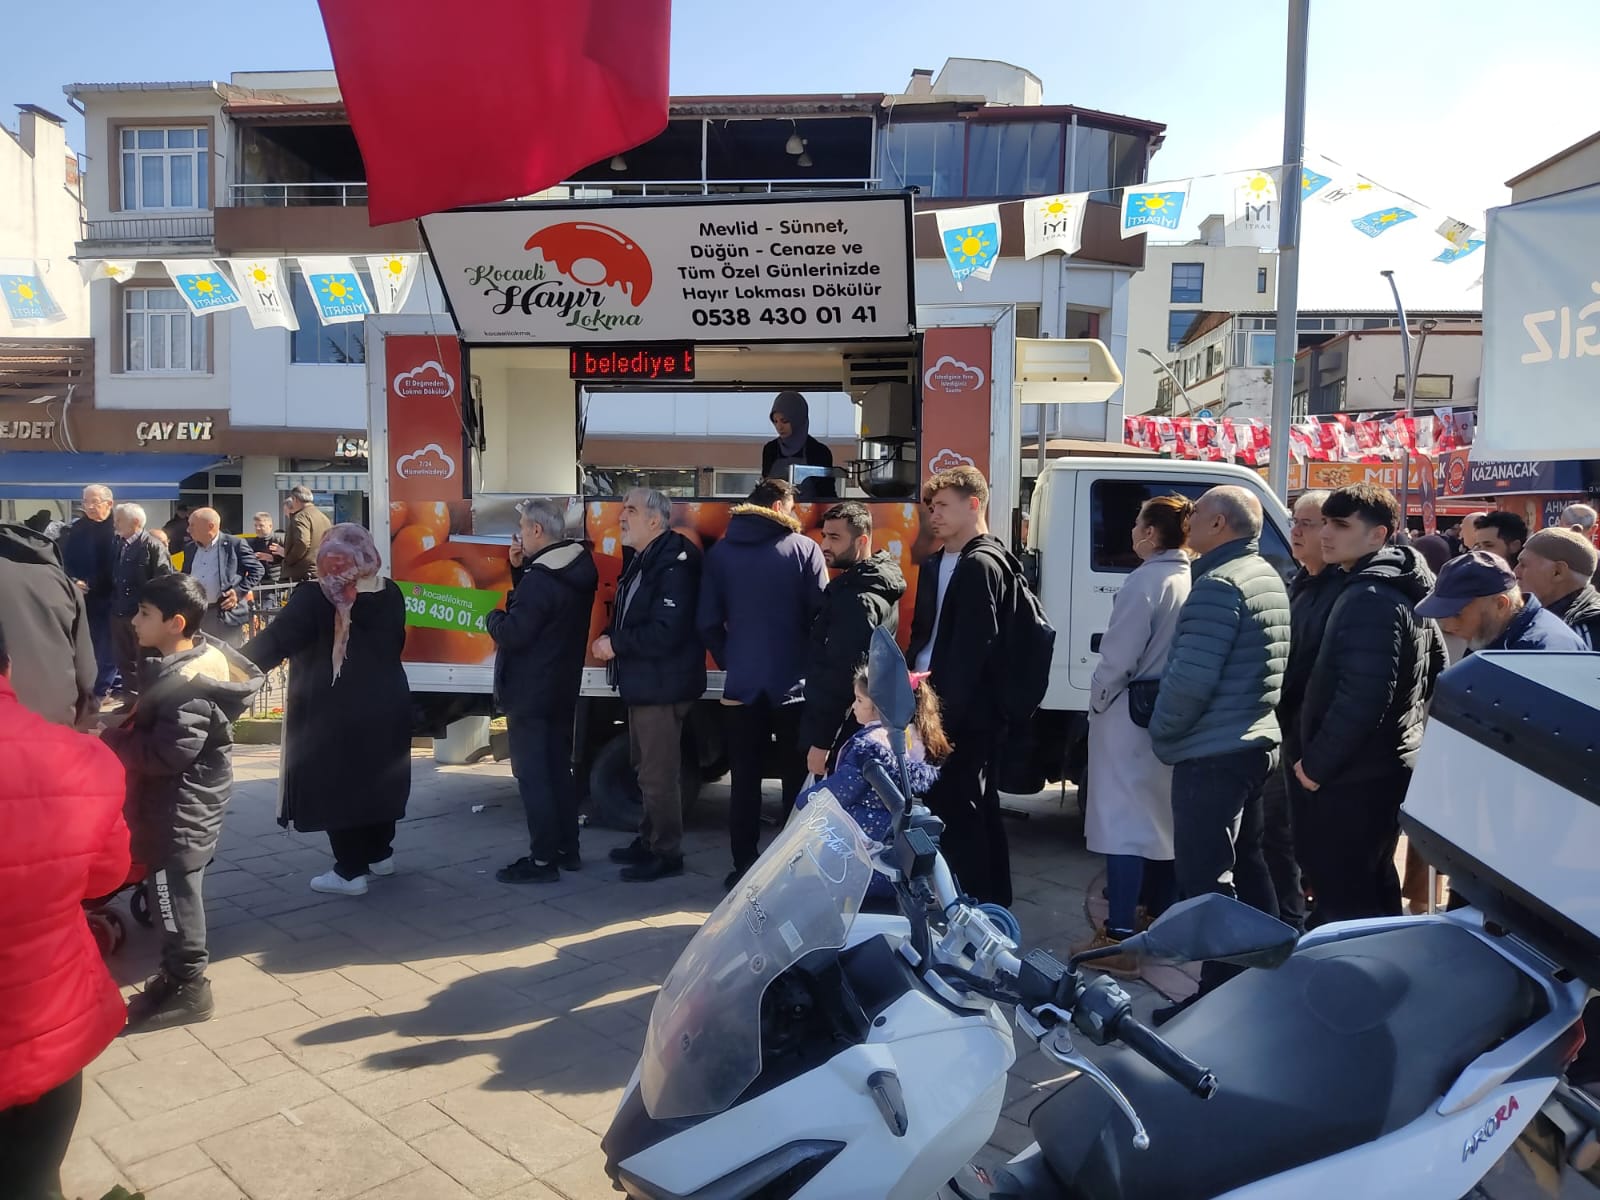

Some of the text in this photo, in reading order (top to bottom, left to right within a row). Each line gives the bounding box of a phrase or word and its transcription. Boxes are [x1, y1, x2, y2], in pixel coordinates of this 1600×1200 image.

[1245, 200, 1271, 221] İYİ
[700, 221, 758, 236] Mevlid
[779, 219, 849, 235] Sünnet,
[1043, 217, 1068, 236] İYİ
[690, 244, 749, 261] Düğün
[770, 242, 836, 257] Cenaze
[842, 243, 863, 254] ve
[464, 263, 547, 288] Kocaeli
[677, 261, 881, 279] Tüm Özel Günlerinizde
[484, 280, 606, 317] Hayır
[682, 282, 882, 303] Hayır Lokması Dökülür
[566, 309, 644, 331] Lokma
[692, 305, 877, 327] 0538 430 01 41
[585, 351, 675, 379] belediye
[136, 416, 213, 446] ÇAY EVİ
[1471, 462, 1539, 481] KAZANACAK
[429, 603, 454, 622] 430
[458, 610, 472, 627] 01
[156, 885, 174, 919] SPORT
[1462, 1095, 1520, 1162] ARORA
